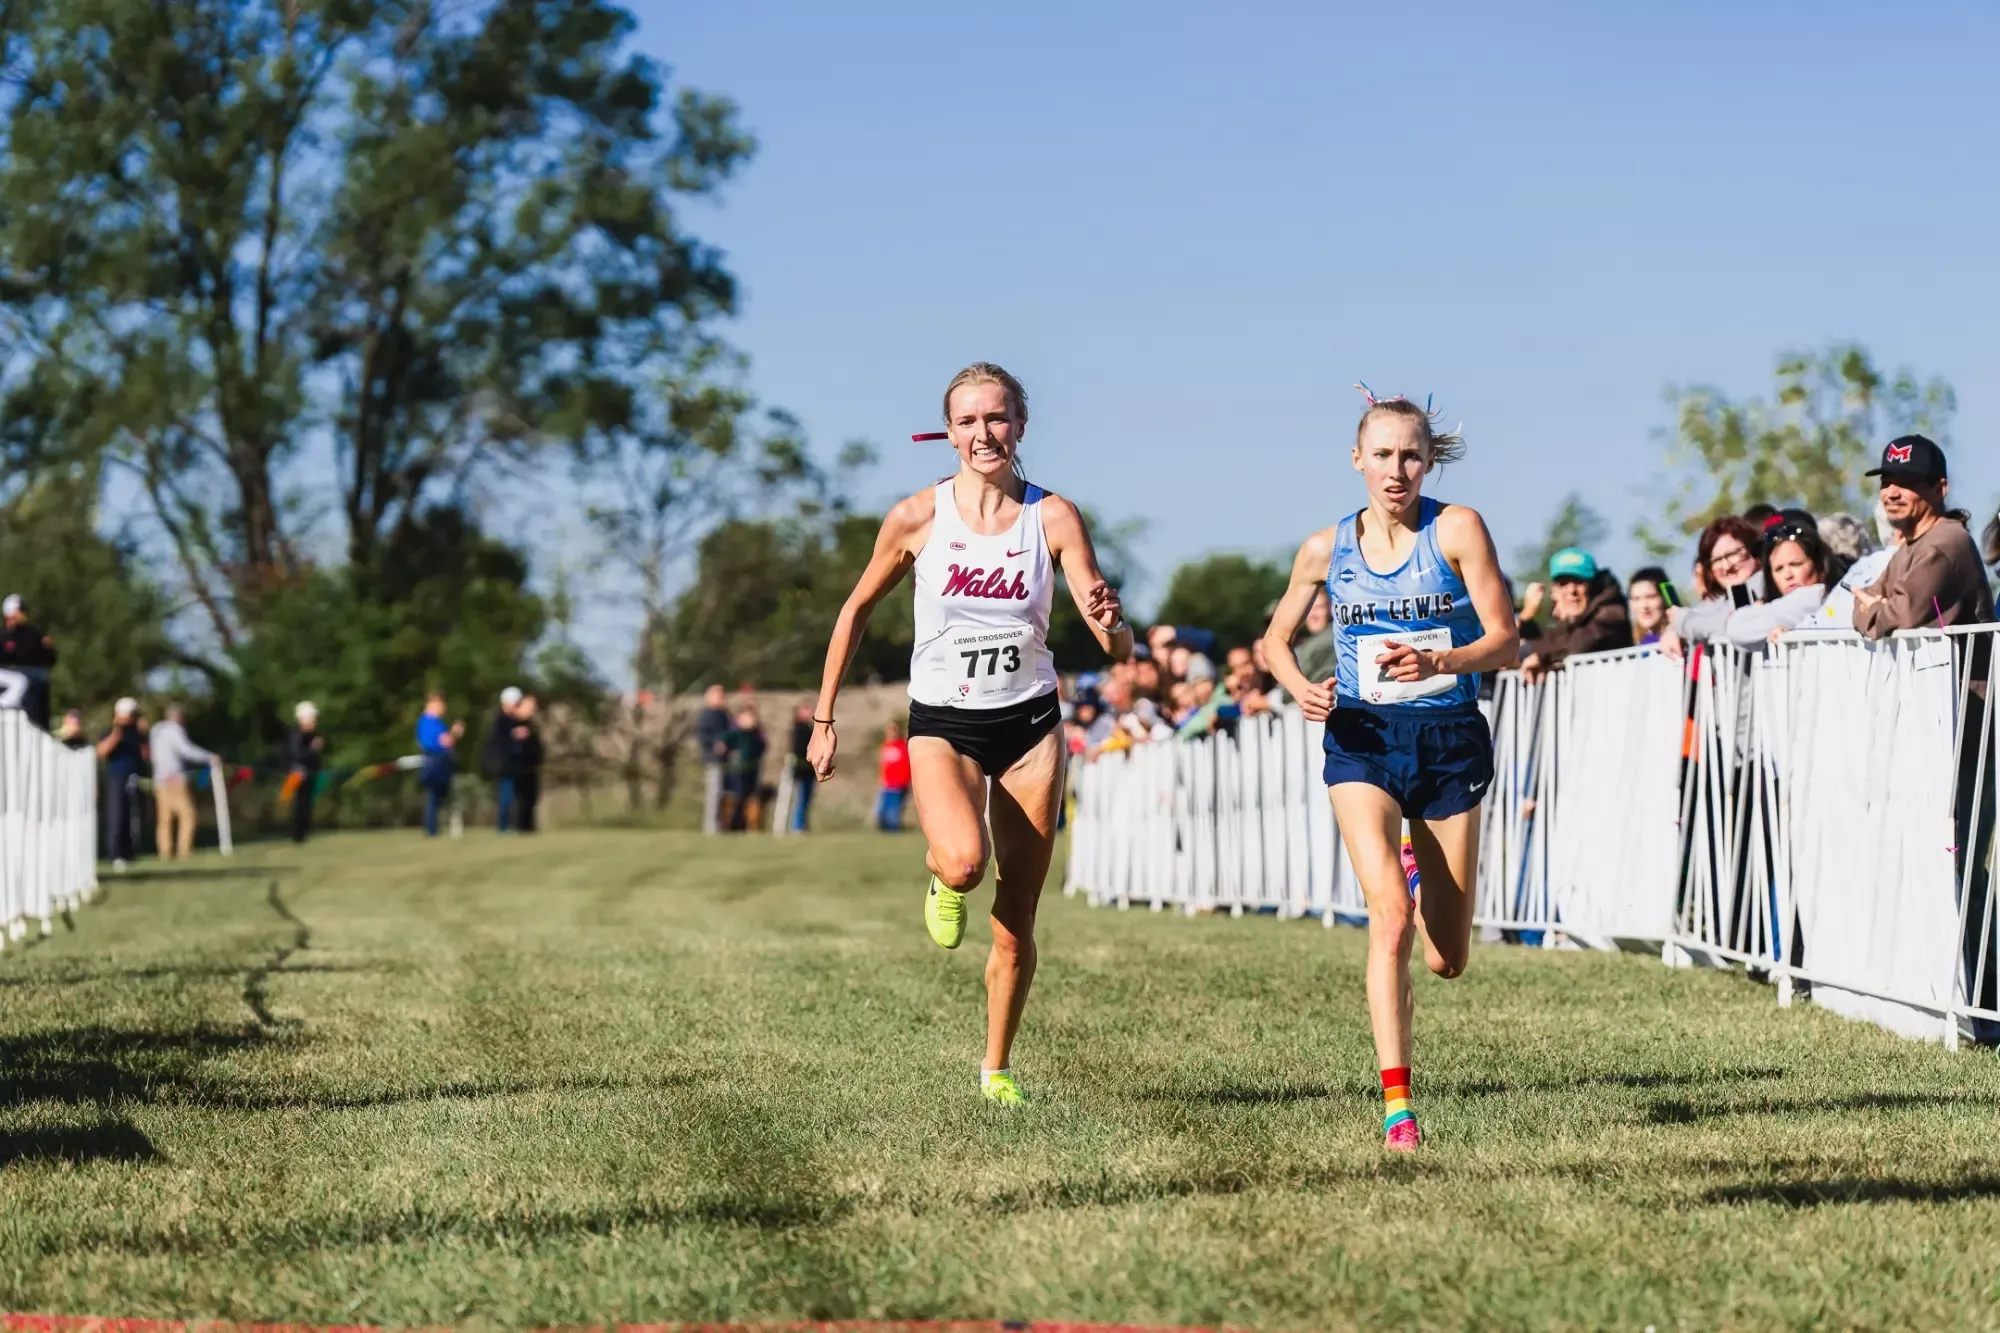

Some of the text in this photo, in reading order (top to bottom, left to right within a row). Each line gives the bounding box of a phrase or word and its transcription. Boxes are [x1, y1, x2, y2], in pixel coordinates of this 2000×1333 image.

[1887, 443, 1912, 463] M
[941, 563, 1030, 600] Walsh
[1387, 592, 1455, 620] LEWIS
[954, 630, 1024, 645] LEWIS CROSSOVER
[960, 645, 1021, 678] 773
